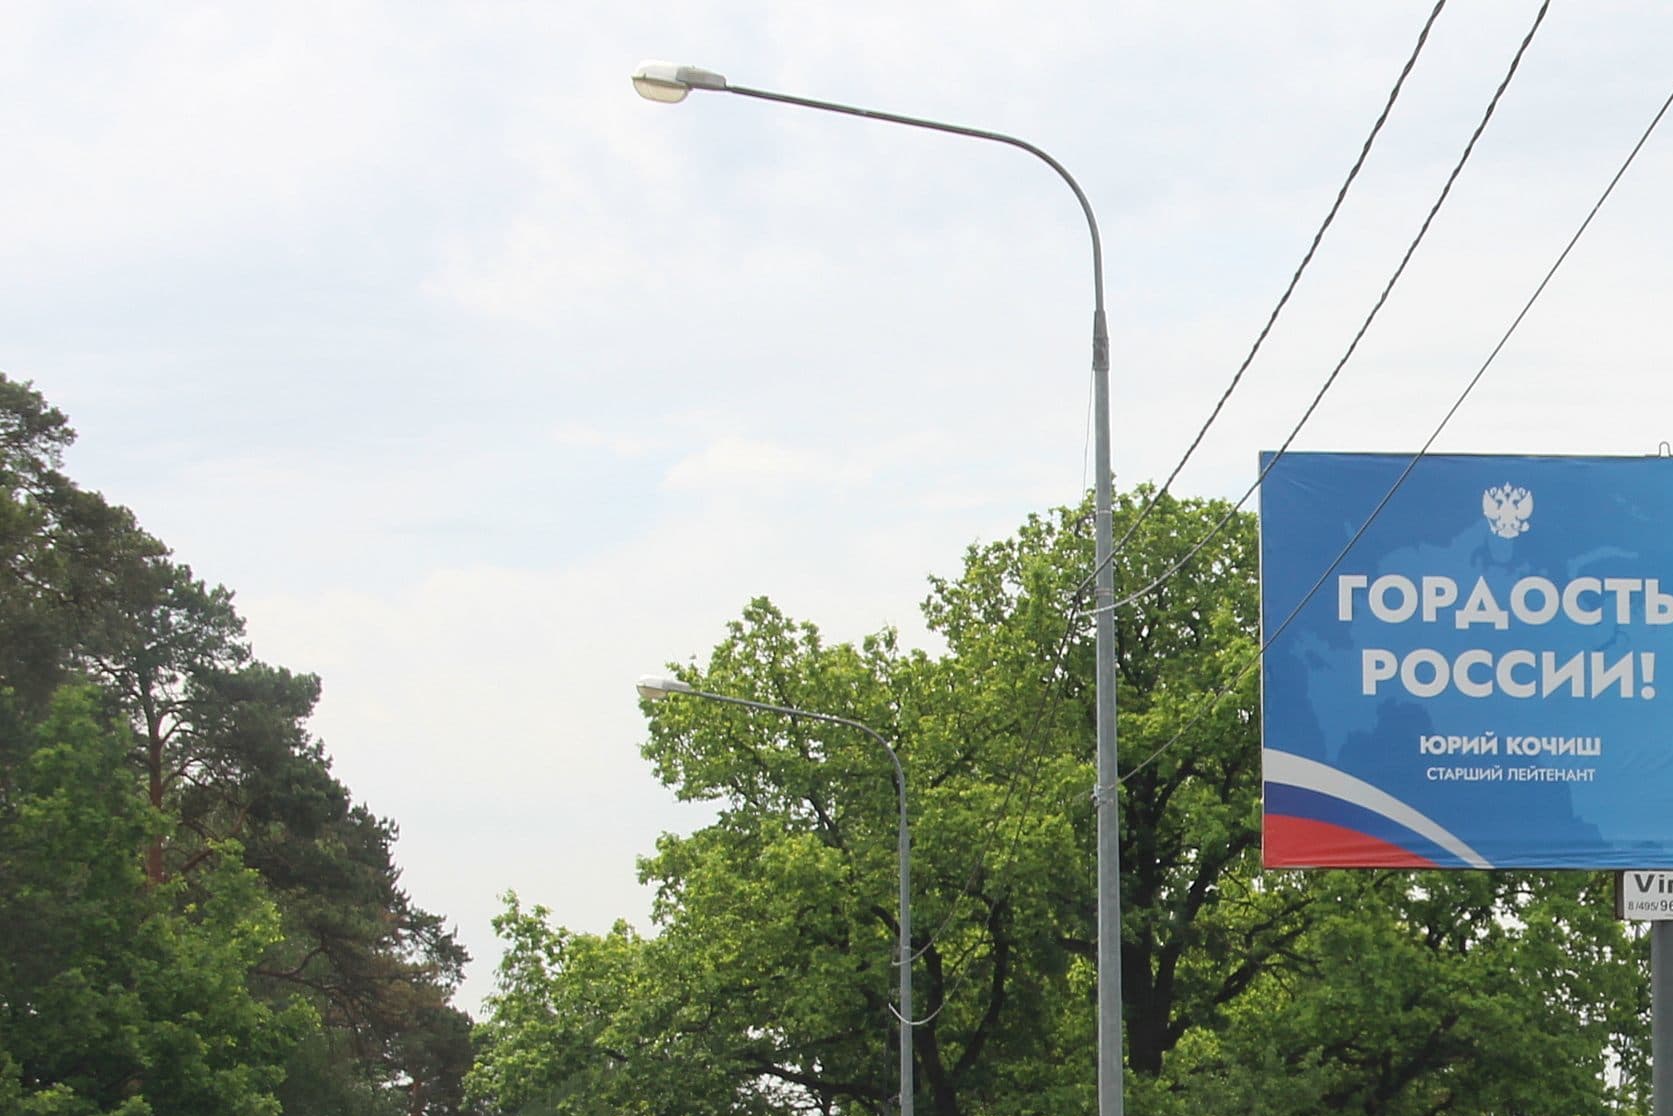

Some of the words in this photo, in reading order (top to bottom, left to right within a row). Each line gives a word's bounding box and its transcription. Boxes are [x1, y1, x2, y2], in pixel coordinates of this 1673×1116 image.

[1361, 648, 1657, 700] РОССИИ!
[1419, 731, 1499, 756] ЮРИЙ
[1506, 736, 1602, 757] КОЧИШ
[1426, 764, 1503, 781] СТАРШИЙ
[1507, 765, 1596, 782] ЛЕЙТЕНАНТ
